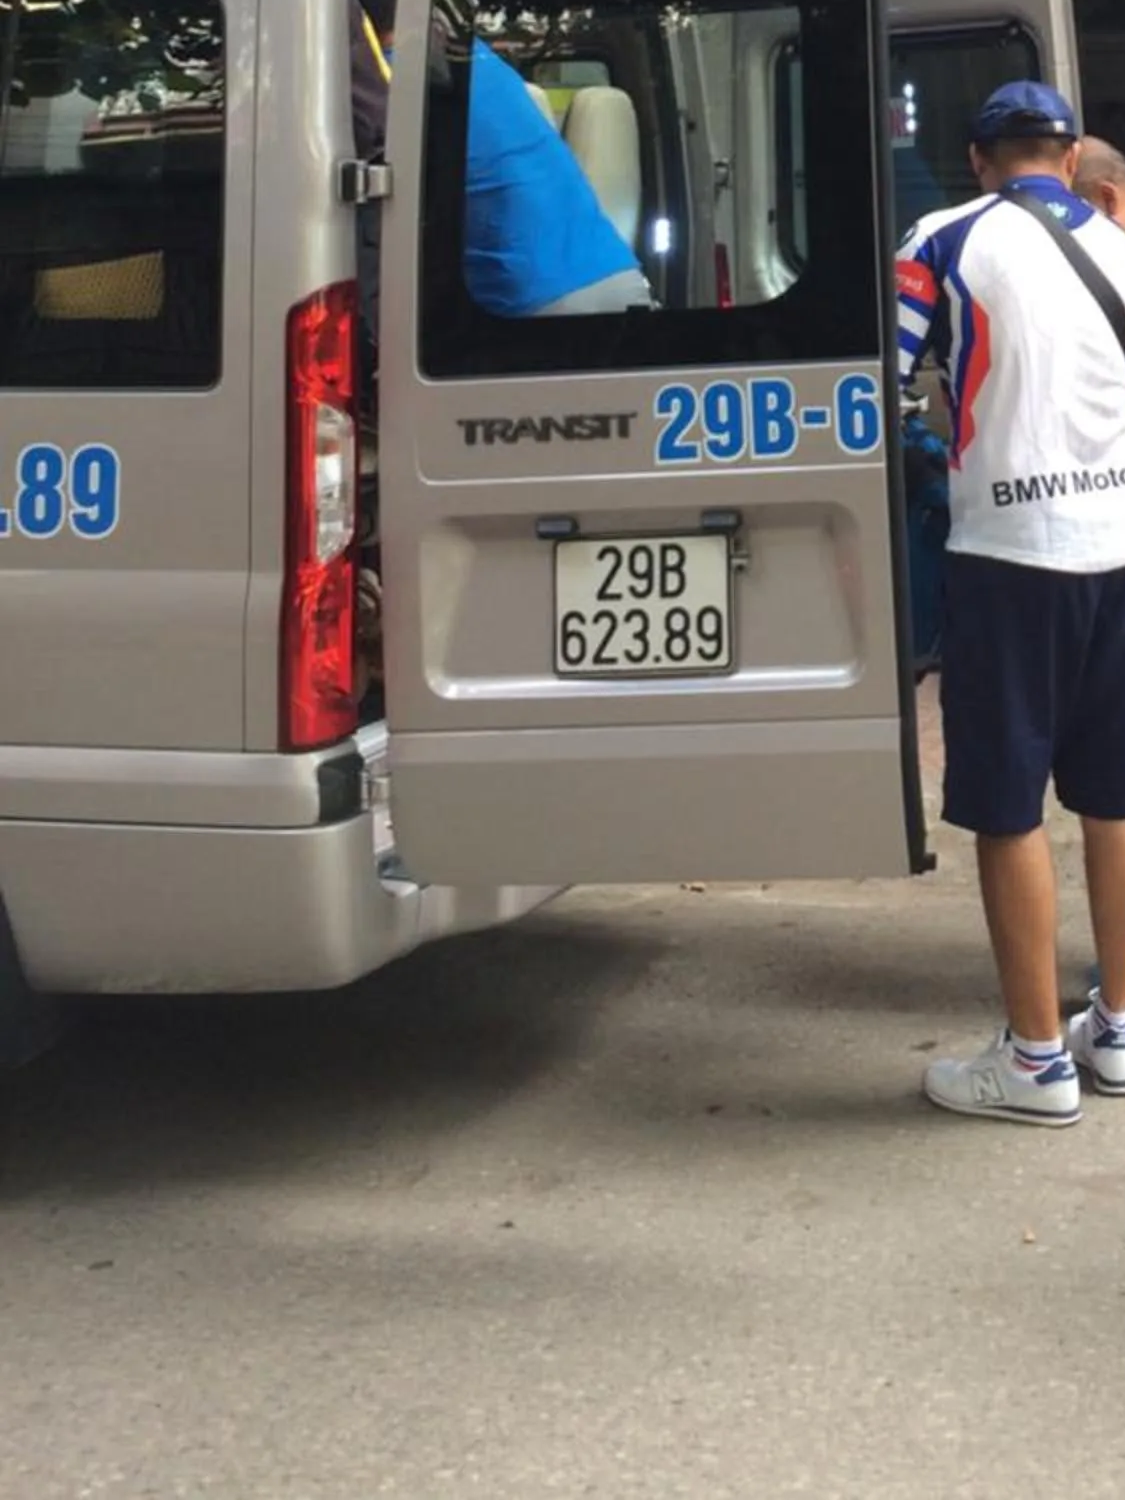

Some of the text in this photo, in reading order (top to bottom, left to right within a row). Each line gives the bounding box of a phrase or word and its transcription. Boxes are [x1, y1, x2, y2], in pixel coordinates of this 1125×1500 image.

[457, 411, 637, 447] TRANSIT
[653, 373, 882, 465] 29B-6
[991, 471, 1067, 508] BMW
[595, 542, 687, 602] 29B
[559, 605, 724, 667] 623.89
